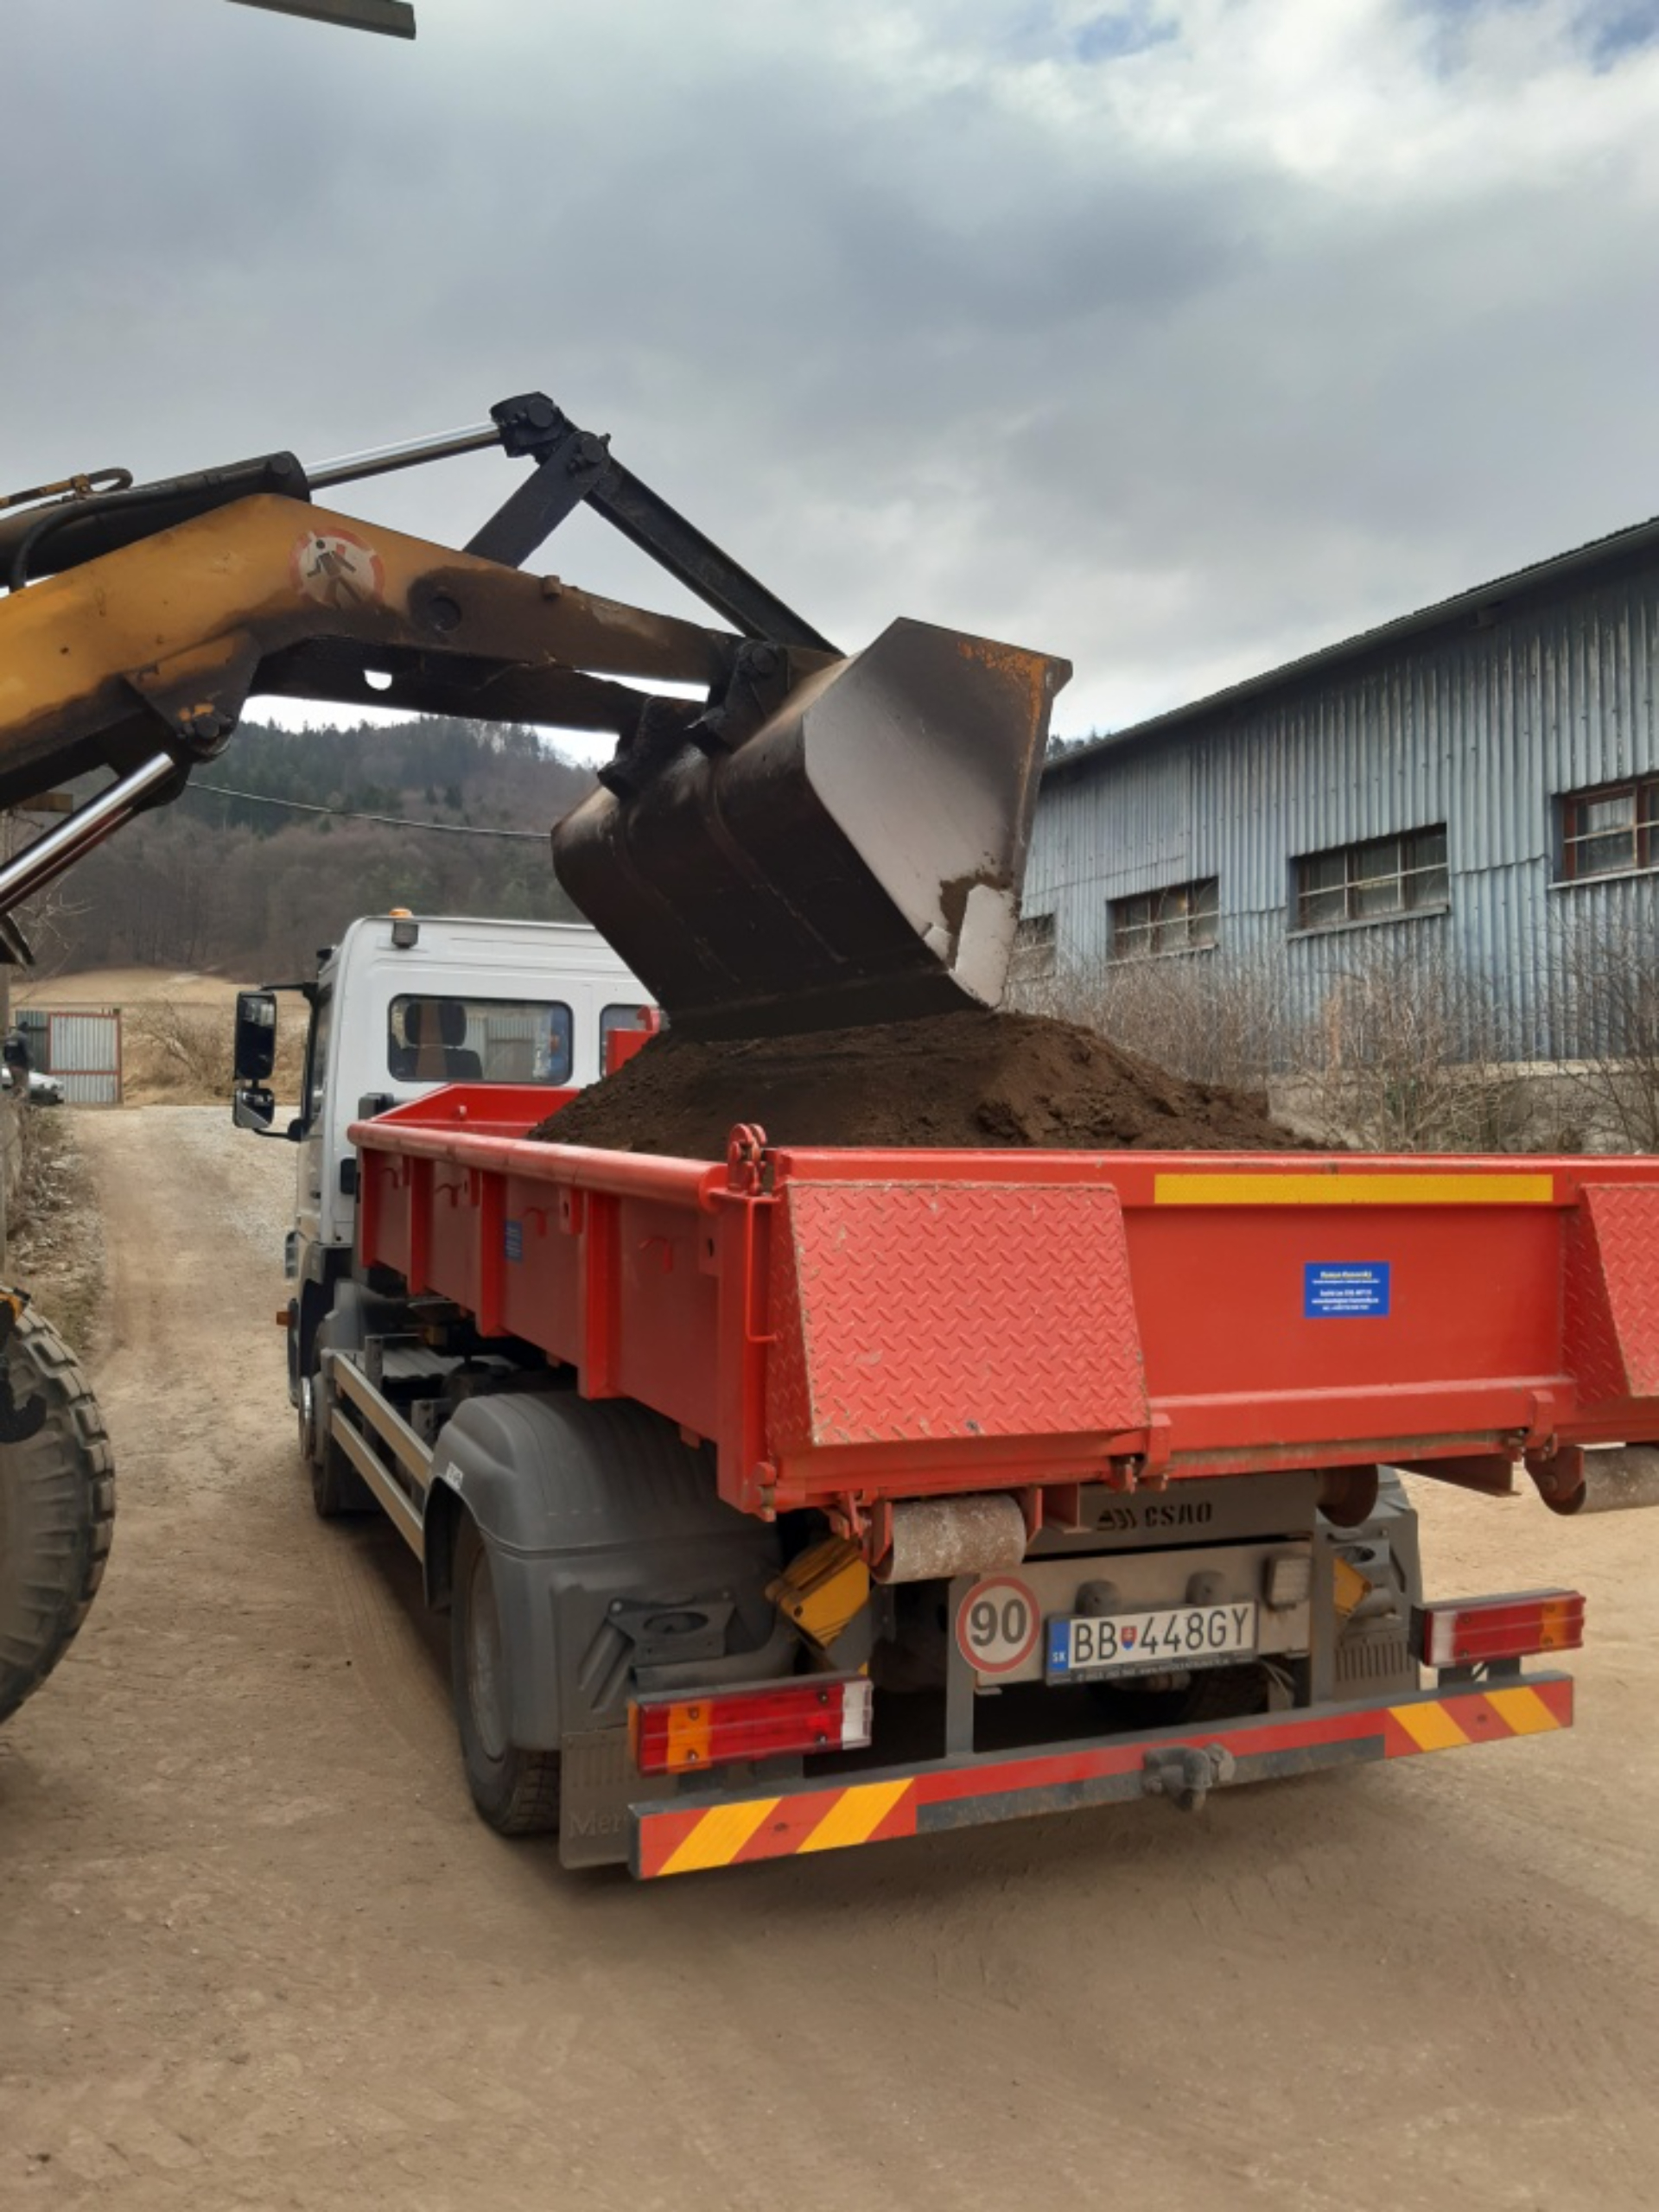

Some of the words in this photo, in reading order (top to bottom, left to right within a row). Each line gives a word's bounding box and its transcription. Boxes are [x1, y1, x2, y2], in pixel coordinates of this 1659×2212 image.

[969, 1598, 1027, 1647] 90
[1073, 1620, 1118, 1662] BB
[1139, 1606, 1249, 1655] 448GY
[1052, 1650, 1067, 1663] SK
